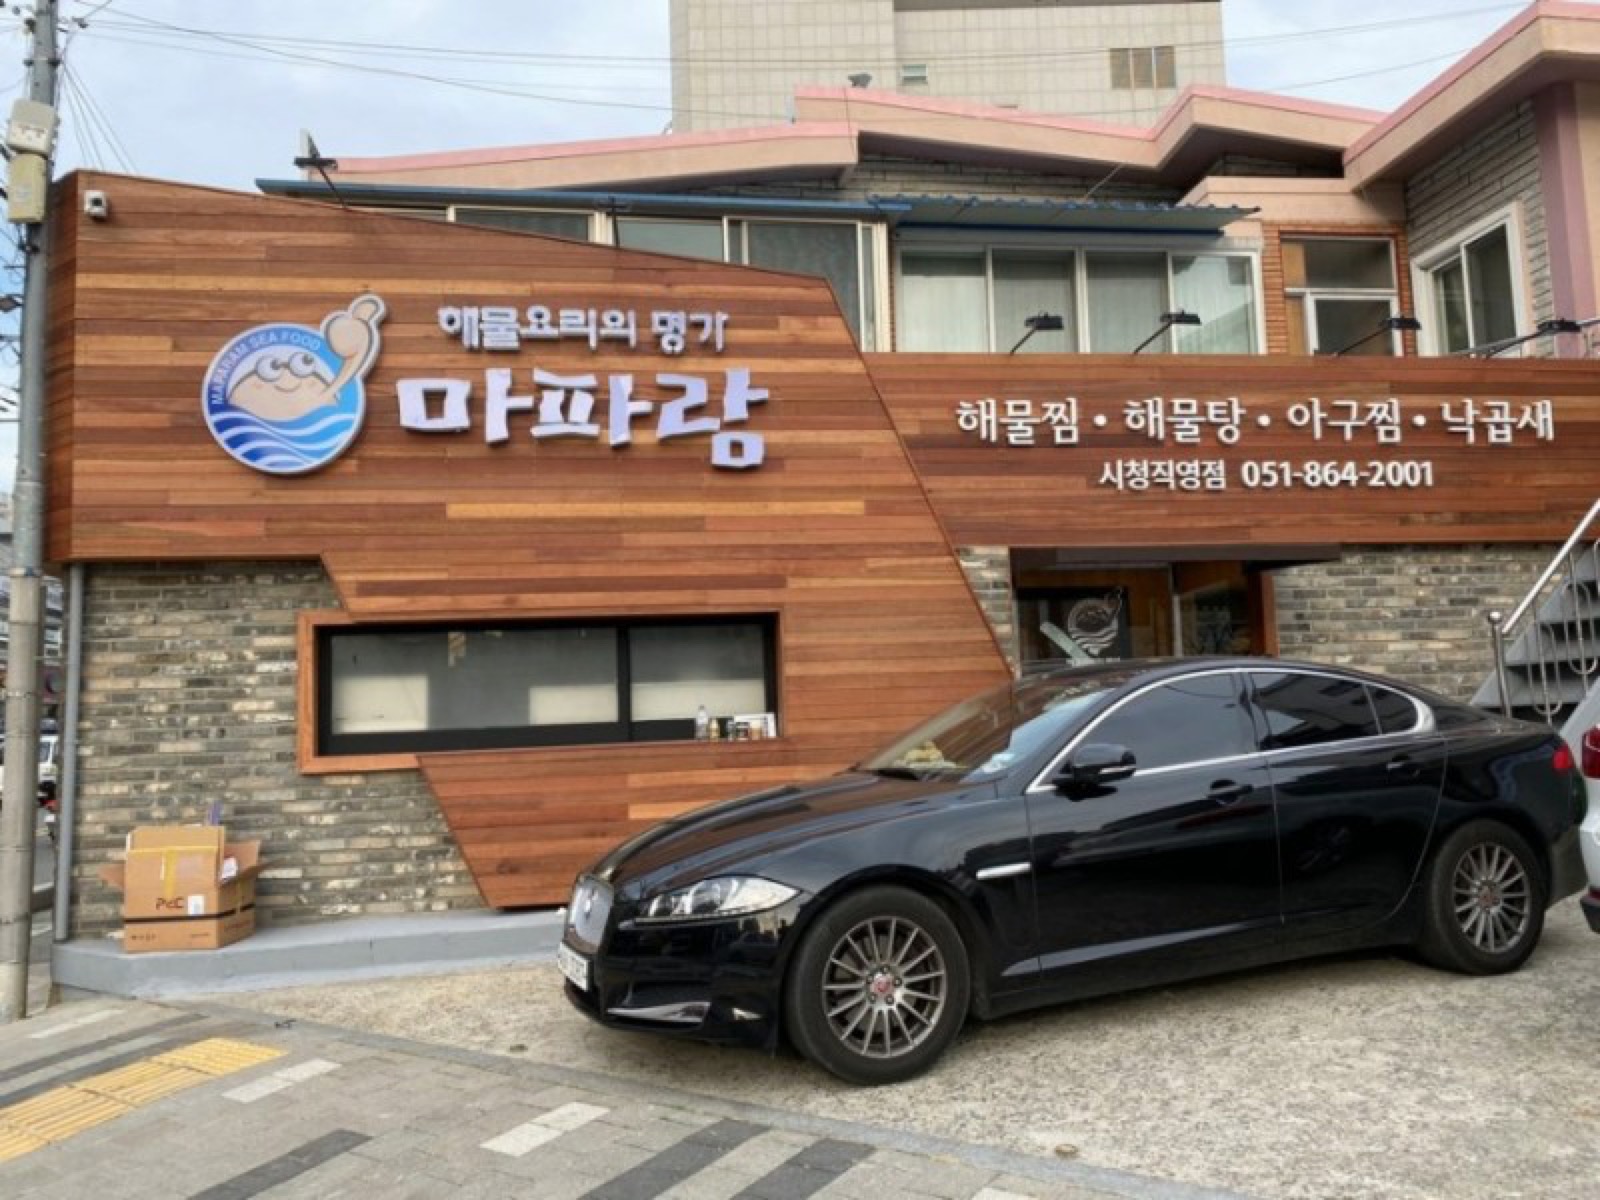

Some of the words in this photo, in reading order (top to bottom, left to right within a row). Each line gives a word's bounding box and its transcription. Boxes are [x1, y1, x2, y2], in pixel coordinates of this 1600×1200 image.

[249, 331, 279, 349] SEA
[281, 331, 321, 352] FOOD
[651, 310, 729, 354] 명가
[396, 367, 769, 469] 마파람
[956, 397, 1079, 445] 해물찜
[1123, 396, 1246, 444] 해물탕
[1287, 397, 1402, 444] 아구찜
[1441, 397, 1555, 445] 낙곱새
[1099, 459, 1226, 491] 시청직영점
[1241, 460, 1434, 488] 051-864-2001
